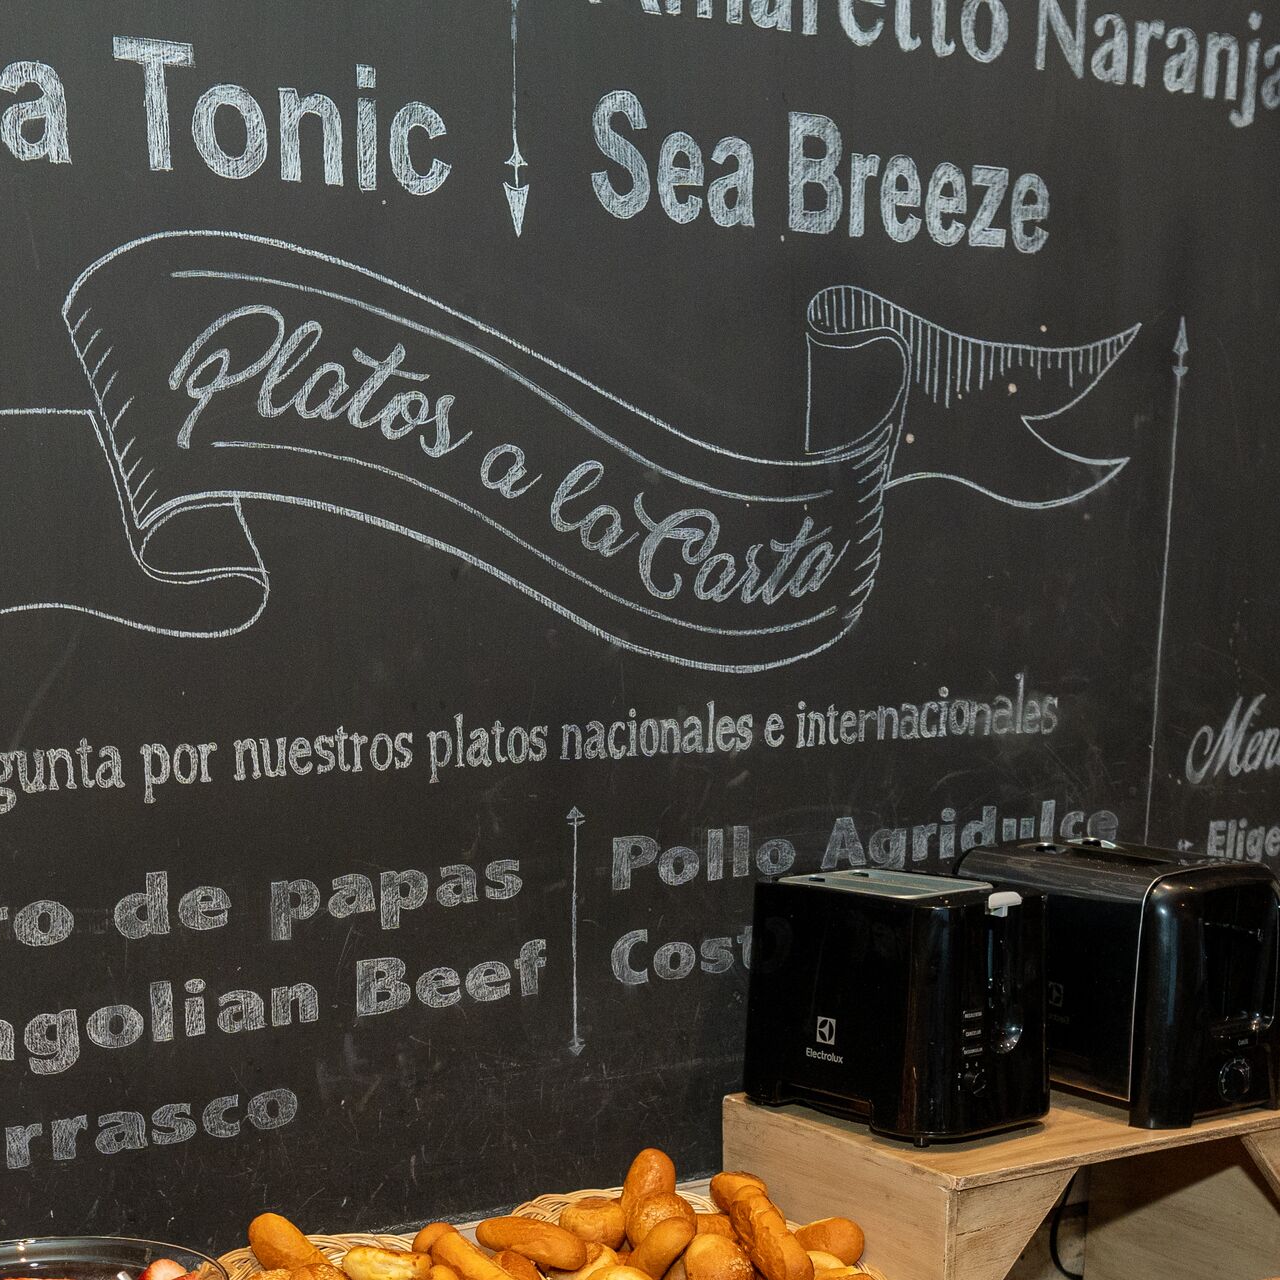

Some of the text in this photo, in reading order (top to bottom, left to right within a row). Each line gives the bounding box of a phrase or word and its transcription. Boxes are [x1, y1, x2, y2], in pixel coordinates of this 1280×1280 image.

[588, 0, 1008, 65] etto
[112, 34, 452, 196] Tonic
[590, 89, 1051, 254] Sea Breeze
[168, 304, 851, 605] Platos a la Carta
[140, 739, 217, 804] por
[233, 725, 415, 781] nuestros
[427, 712, 549, 784] platos
[558, 699, 754, 762] nacionales
[764, 711, 786, 749] e
[795, 672, 1060, 749] internacionales
[114, 869, 232, 941] de
[269, 855, 523, 942] papas
[610, 824, 797, 892] Pollo
[355, 936, 549, 1018] Beef
[805, 1046, 844, 1065] Electrolux
